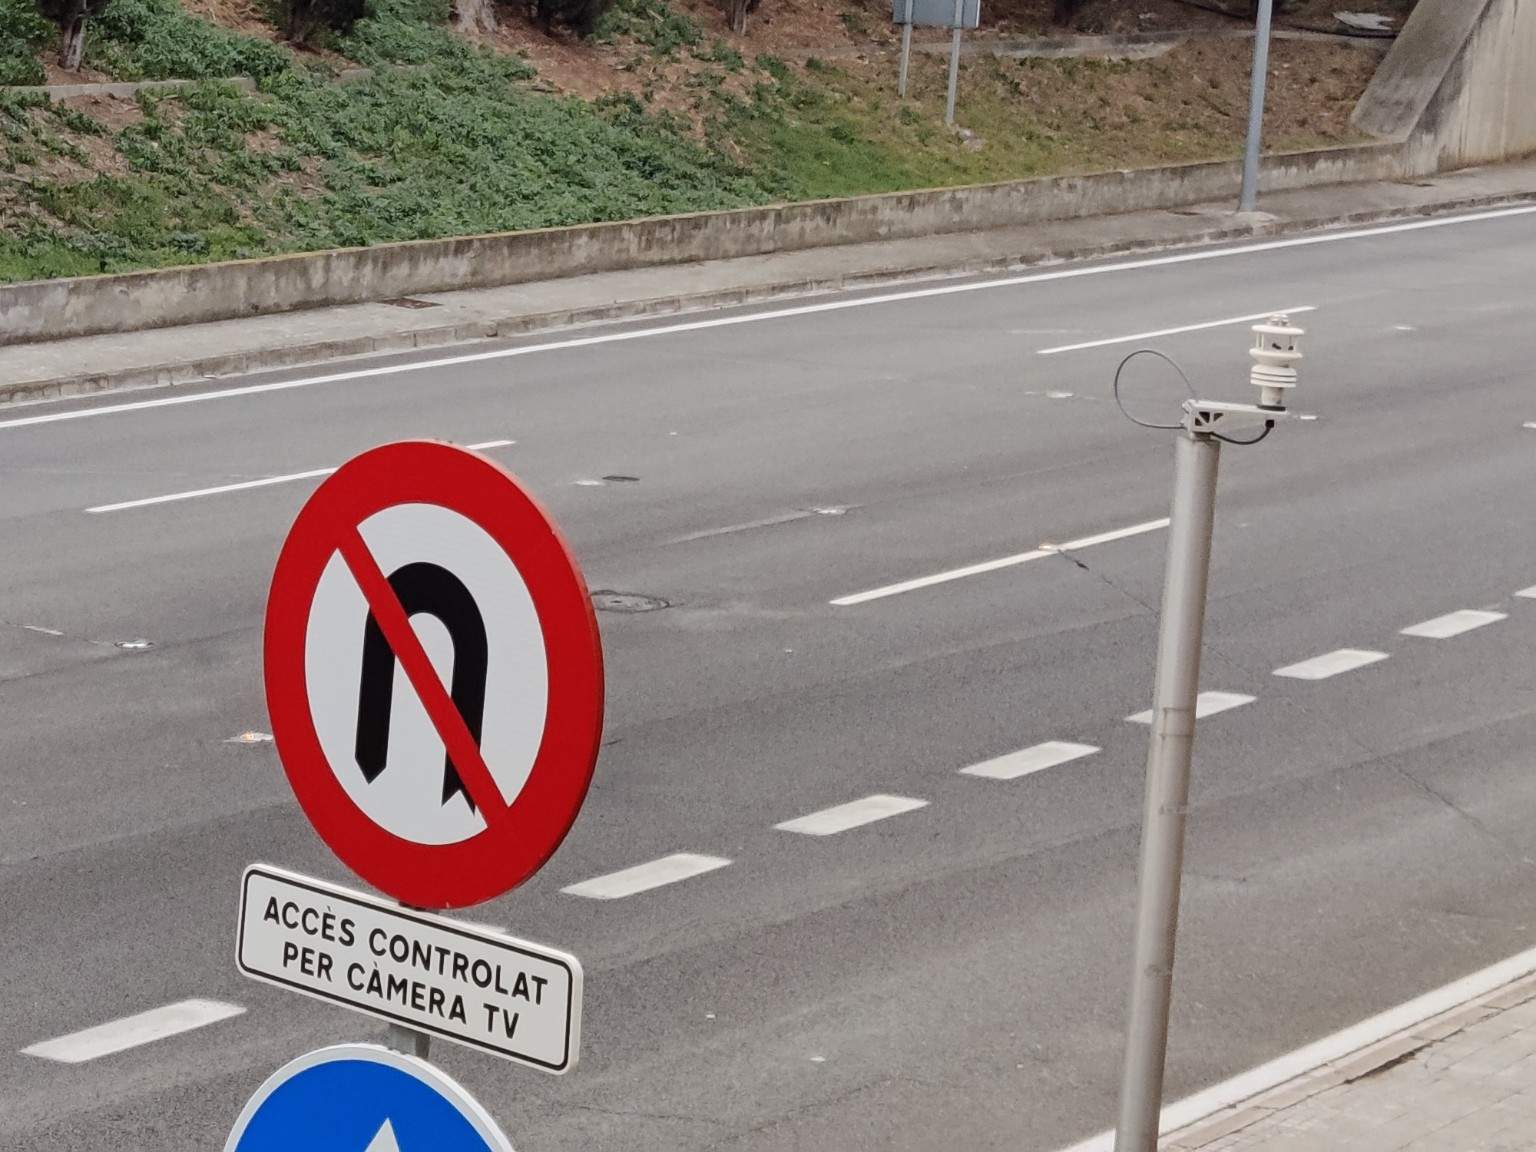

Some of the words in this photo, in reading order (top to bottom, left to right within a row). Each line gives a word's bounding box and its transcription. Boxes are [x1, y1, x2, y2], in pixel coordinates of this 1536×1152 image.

[263, 895, 356, 947] ACCÈS
[368, 928, 548, 1005] CONTROLAT
[283, 941, 334, 982] PER
[346, 961, 468, 1025] CÀMERA
[482, 1002, 520, 1039] TV
